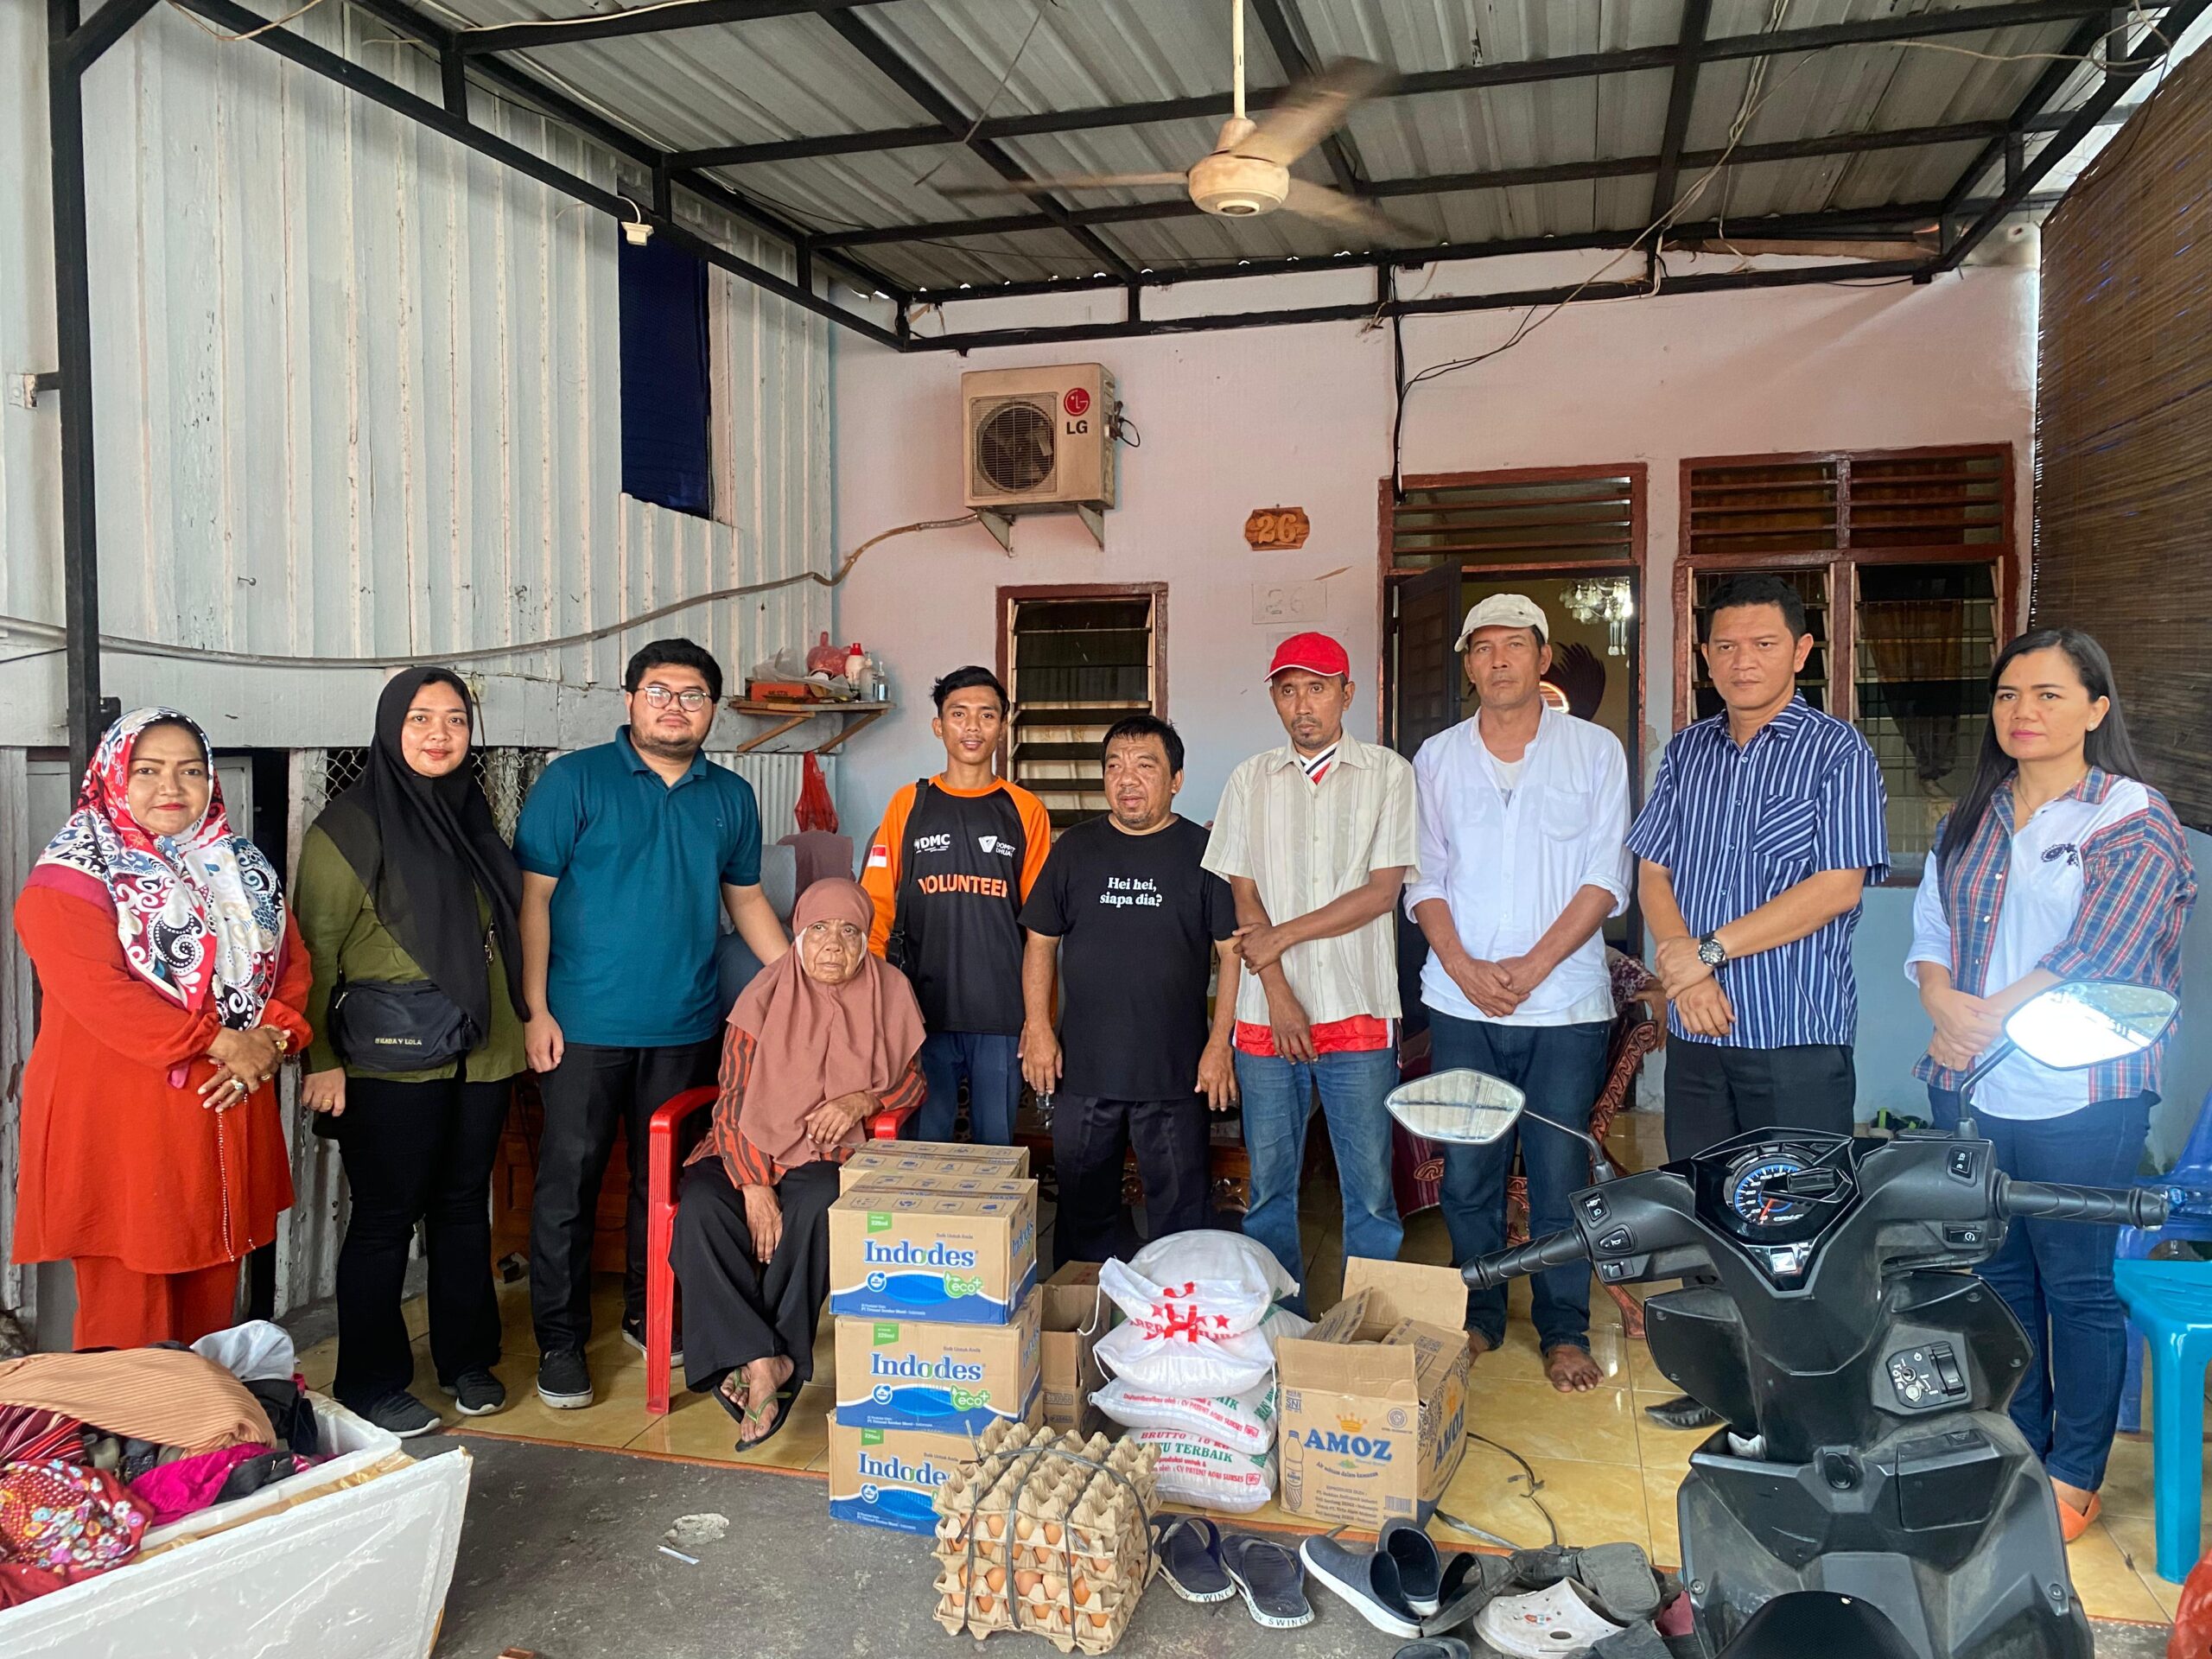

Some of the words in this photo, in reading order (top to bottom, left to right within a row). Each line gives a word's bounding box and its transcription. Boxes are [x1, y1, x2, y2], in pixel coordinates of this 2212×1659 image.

[1066, 420, 1088, 435] LG
[1257, 513, 1296, 543] 26
[1108, 877, 1131, 890] Hei
[1133, 878, 1157, 892] hei,
[1099, 892, 1133, 908] siapa
[1135, 893, 1163, 907] dia?
[864, 1240, 976, 1267] Indodes
[870, 1352, 982, 1381] Indodes
[1140, 1431, 1186, 1440] BRUTTO
[1198, 1435, 1211, 1444] 10
[1303, 1428, 1393, 1461] AMOZ
[1175, 1442, 1233, 1463] TERBAIK
[858, 1452, 951, 1485] Indode
